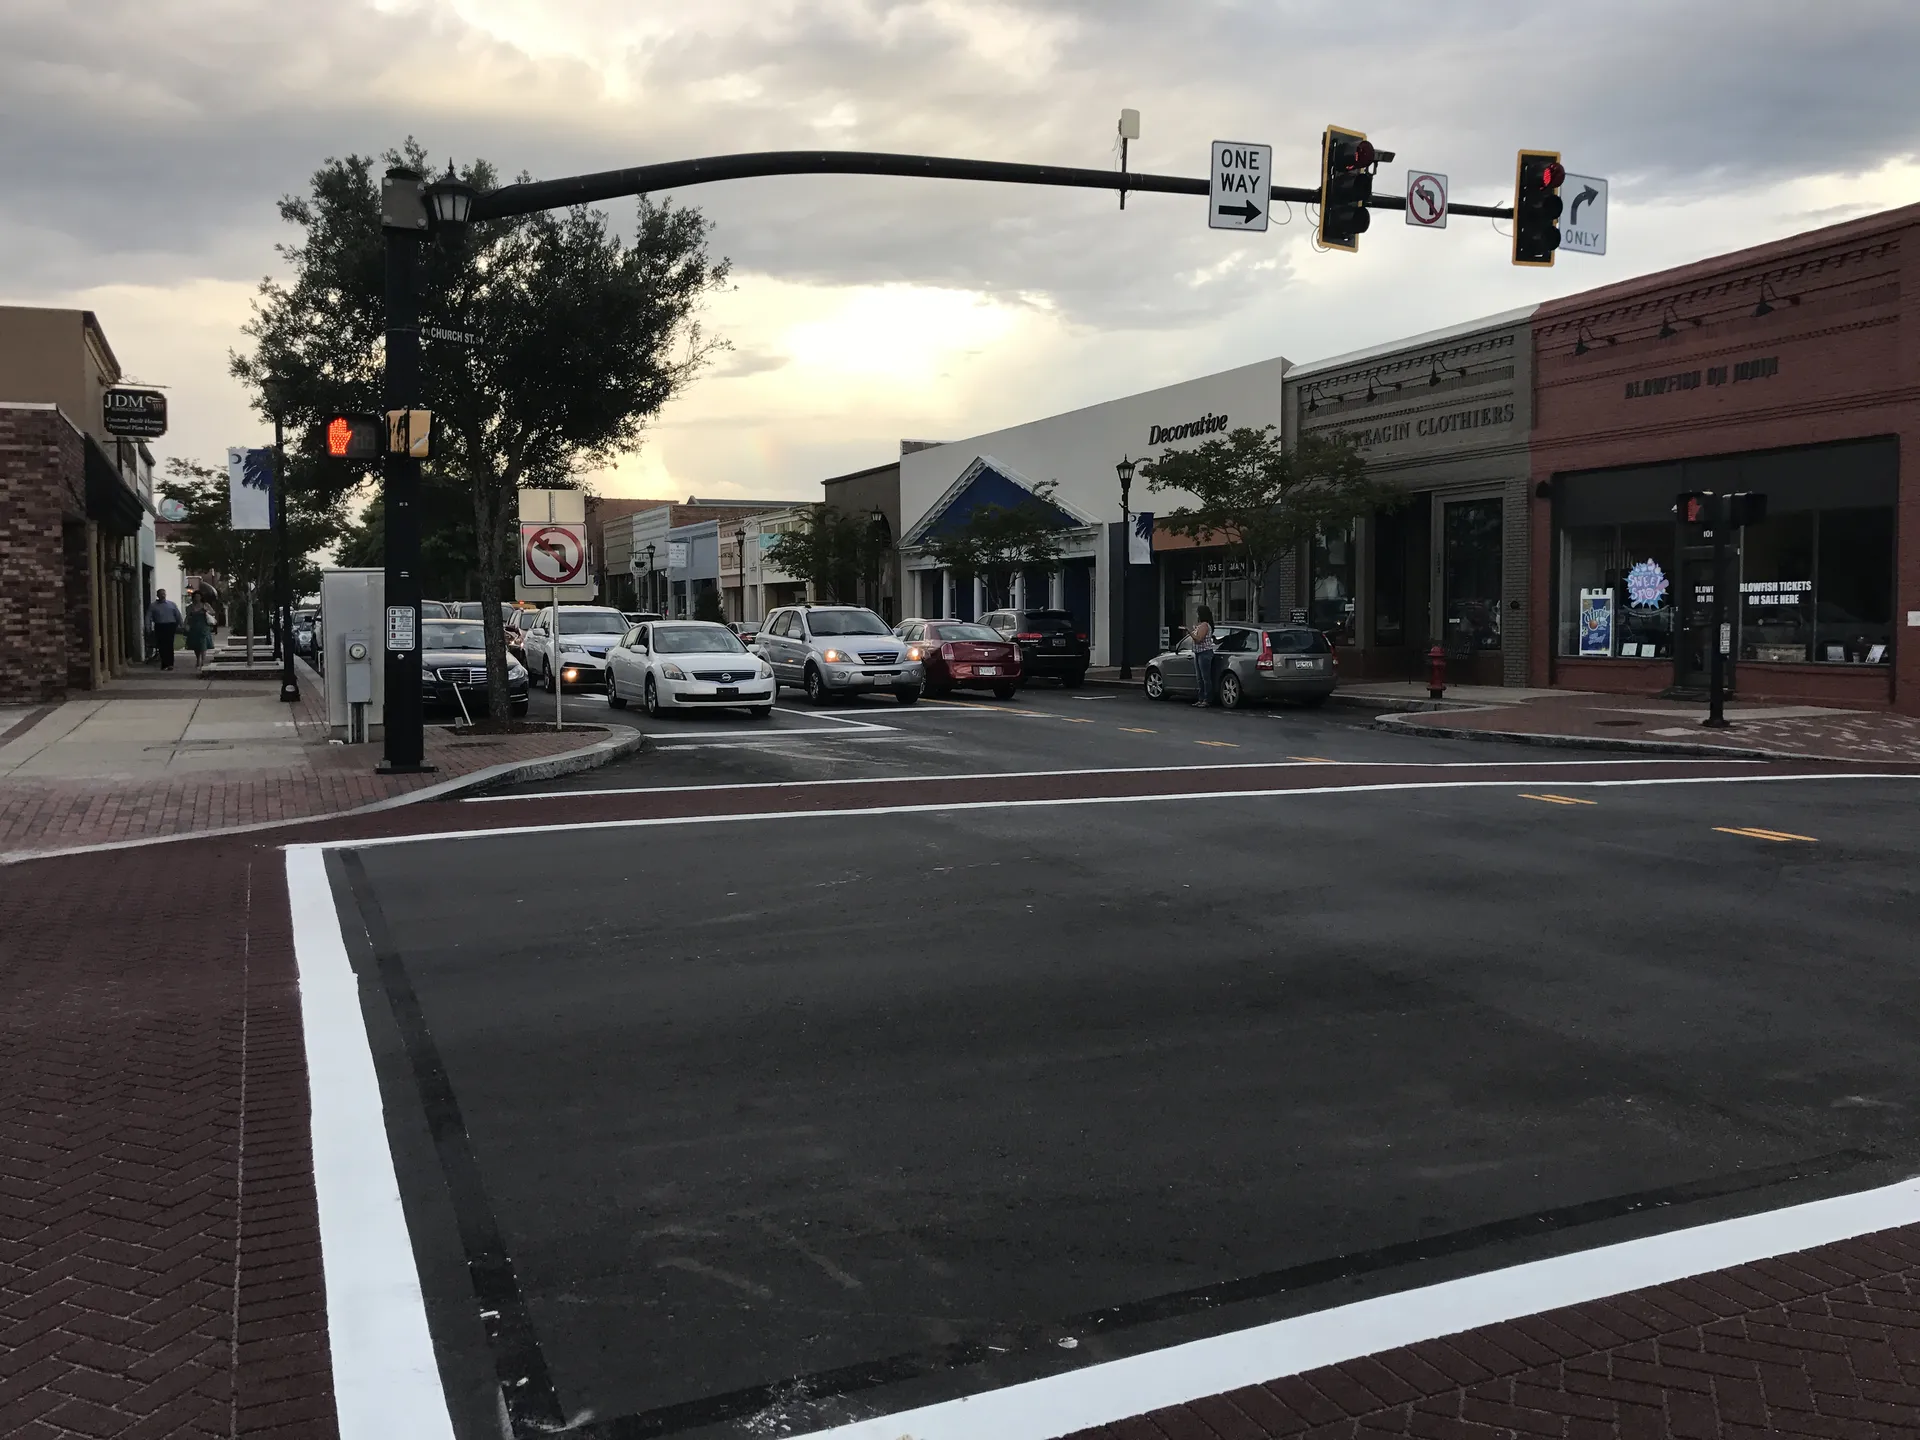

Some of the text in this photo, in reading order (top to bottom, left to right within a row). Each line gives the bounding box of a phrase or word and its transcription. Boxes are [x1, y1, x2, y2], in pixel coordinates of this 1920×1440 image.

[1221, 149, 1259, 170] ONE
[1221, 172, 1261, 194] WAY
[1565, 229, 1599, 248] ONLY
[431, 327, 463, 343] CHURCH
[464, 332, 475, 345] ST.
[104, 394, 144, 409] JDM
[1416, 403, 1514, 437] CLOTHIERS
[1148, 412, 1228, 446] Decorative
[1703, 529, 1713, 538] 101
[1627, 574, 1664, 588] SWEET
[1739, 580, 1812, 593] BLOWFISH TICKETS
[1630, 587, 1662, 601] SPOT
[1748, 593, 1799, 605] ON SALE HERE
